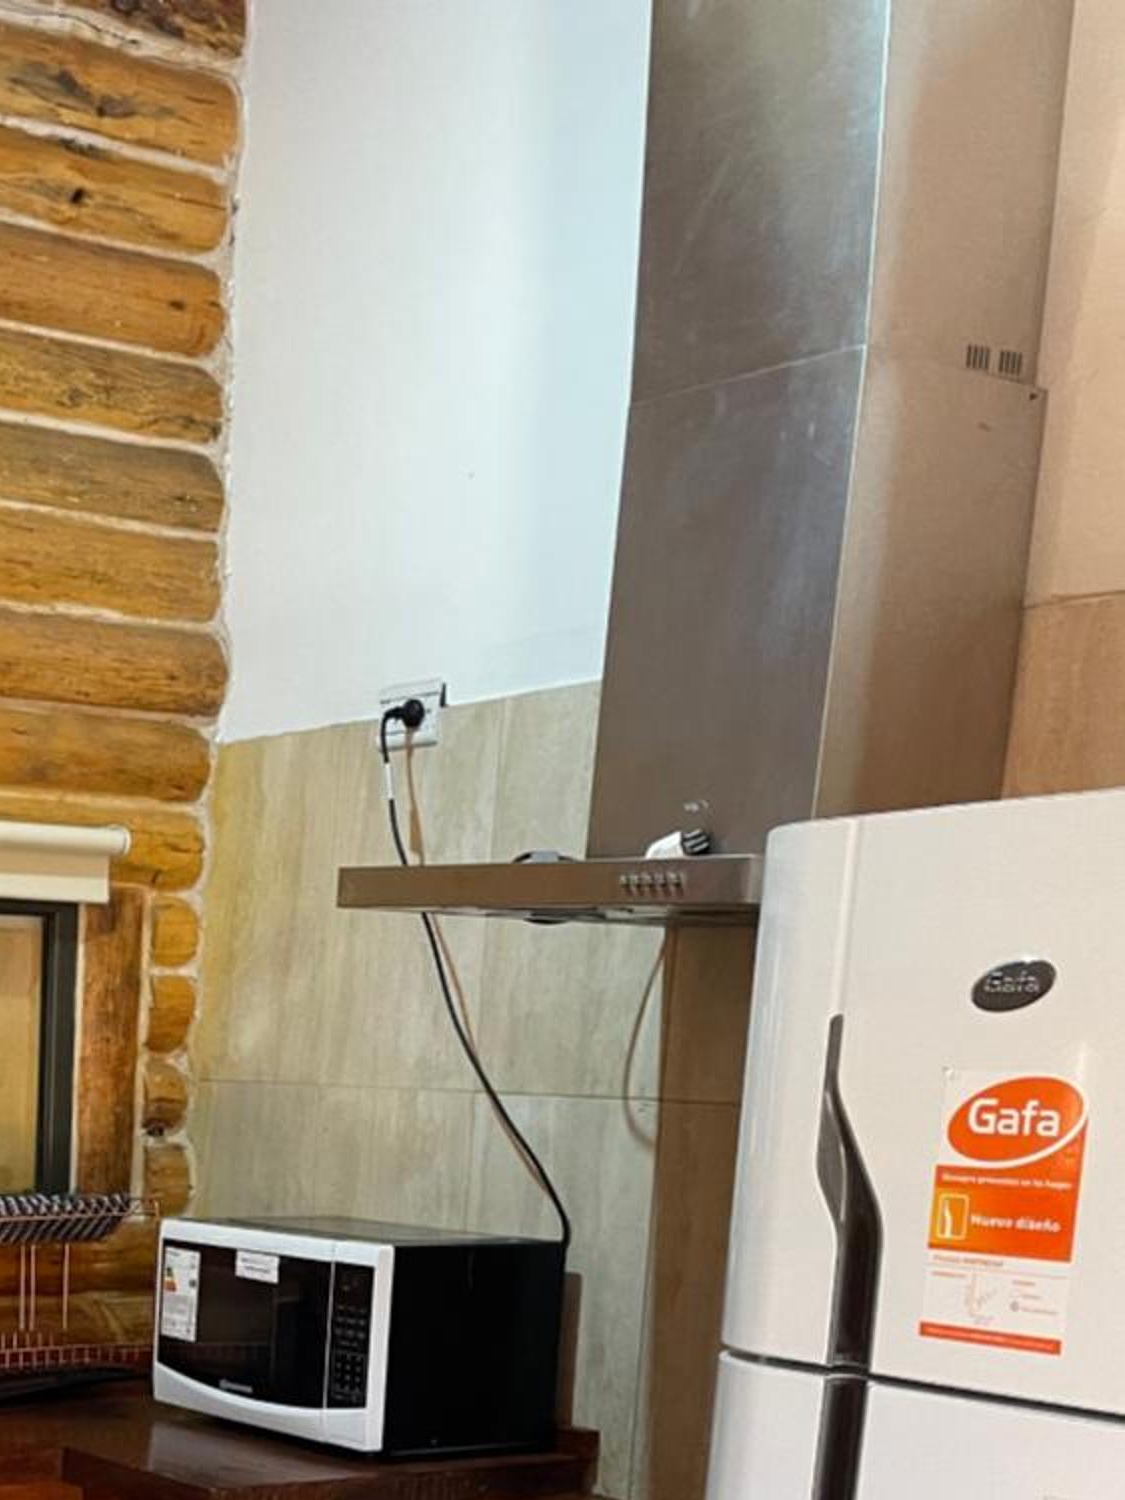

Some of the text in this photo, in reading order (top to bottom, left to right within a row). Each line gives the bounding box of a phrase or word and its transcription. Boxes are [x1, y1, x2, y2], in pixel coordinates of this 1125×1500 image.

[969, 1097, 1060, 1137] Gafa
[970, 1214, 1061, 1233] Nuevo diseño
